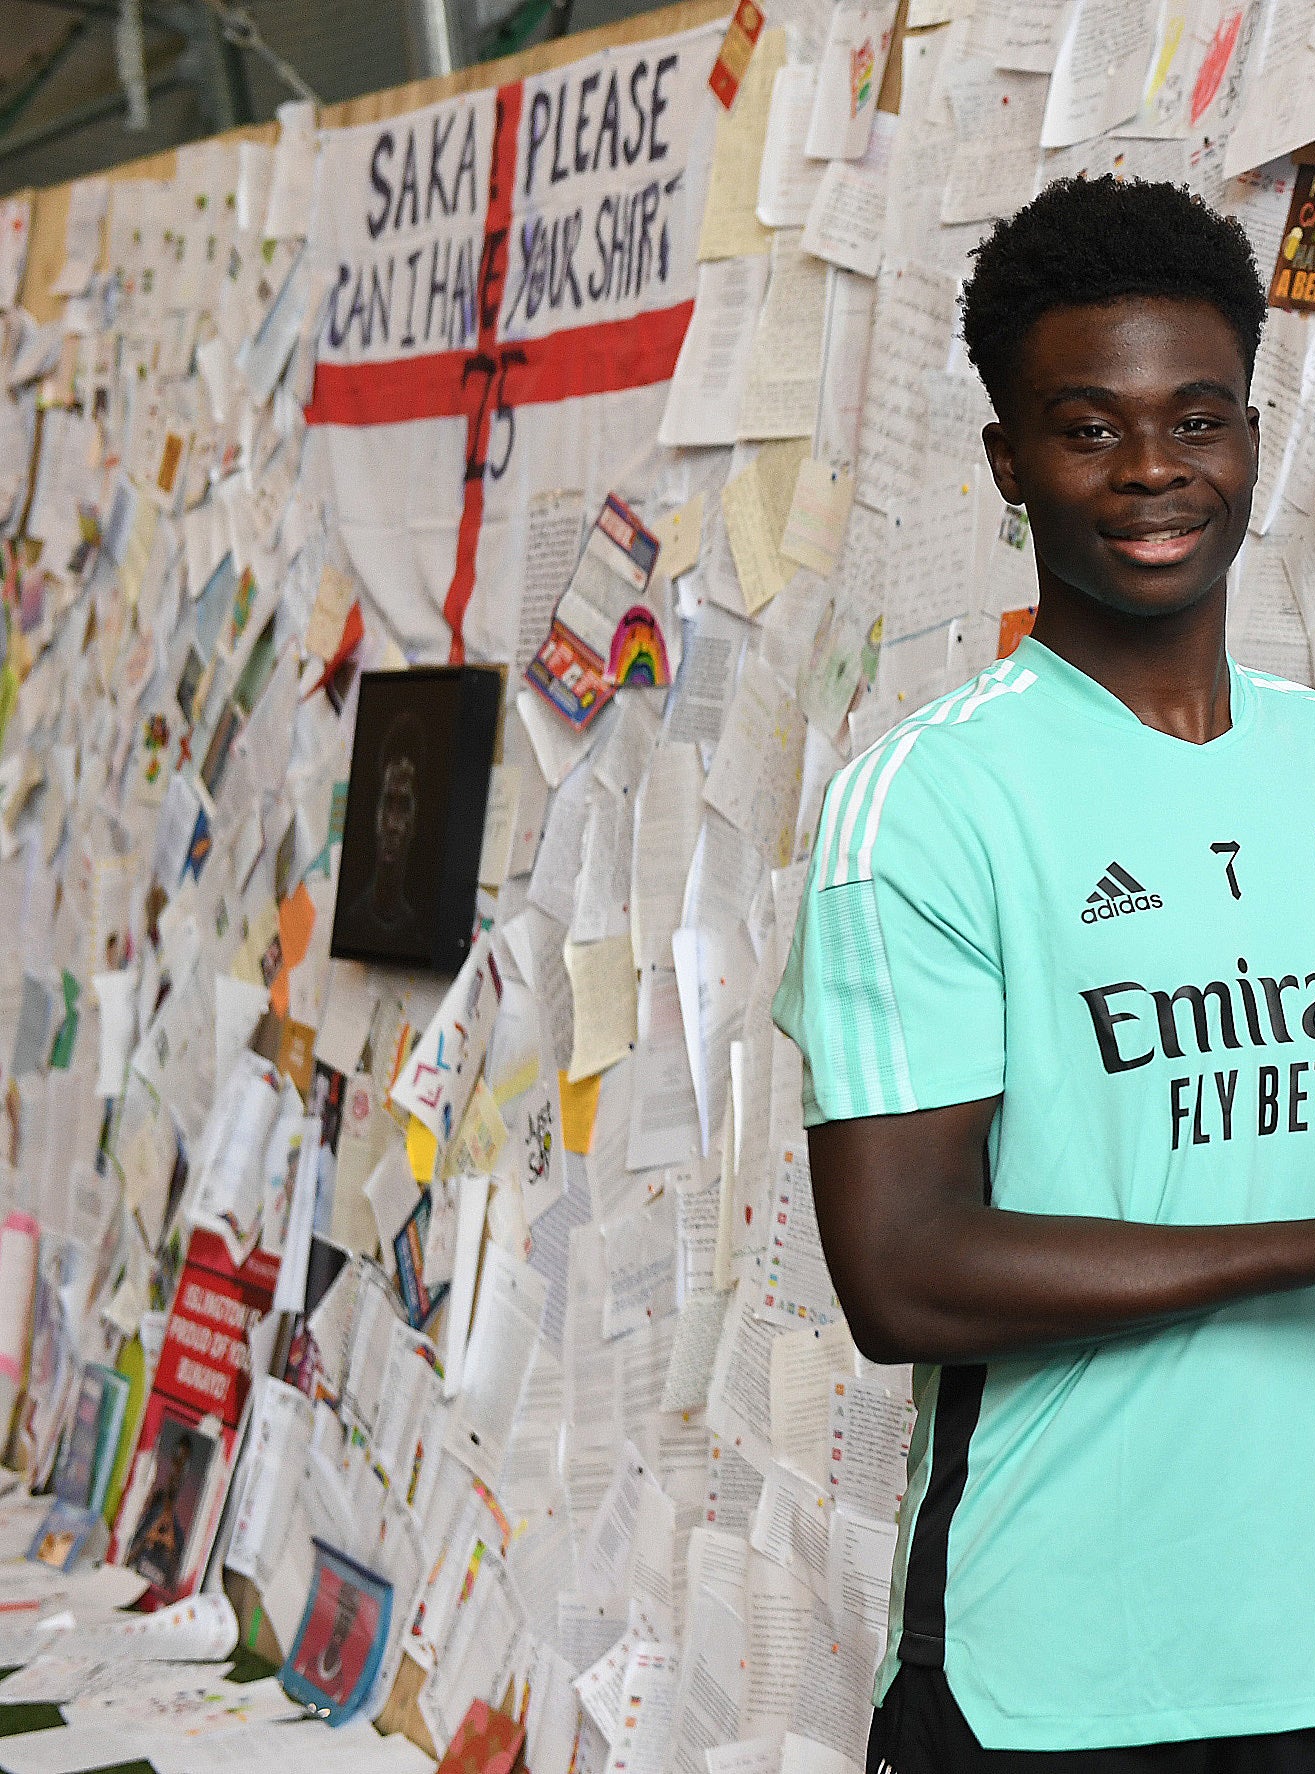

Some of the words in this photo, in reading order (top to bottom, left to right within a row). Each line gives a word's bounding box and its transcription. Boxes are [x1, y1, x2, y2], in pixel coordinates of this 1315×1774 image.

[523, 54, 679, 195] PLEASE
[328, 257, 394, 350] CAN
[400, 250, 421, 347] I
[425, 229, 507, 350] HAVE
[504, 205, 582, 329] YOUR
[587, 168, 684, 302] SHIRT
[1276, 269, 1292, 298] A
[1209, 840, 1241, 901] 7
[1080, 892, 1164, 925] adidas
[1170, 1068, 1239, 1151] FLY
